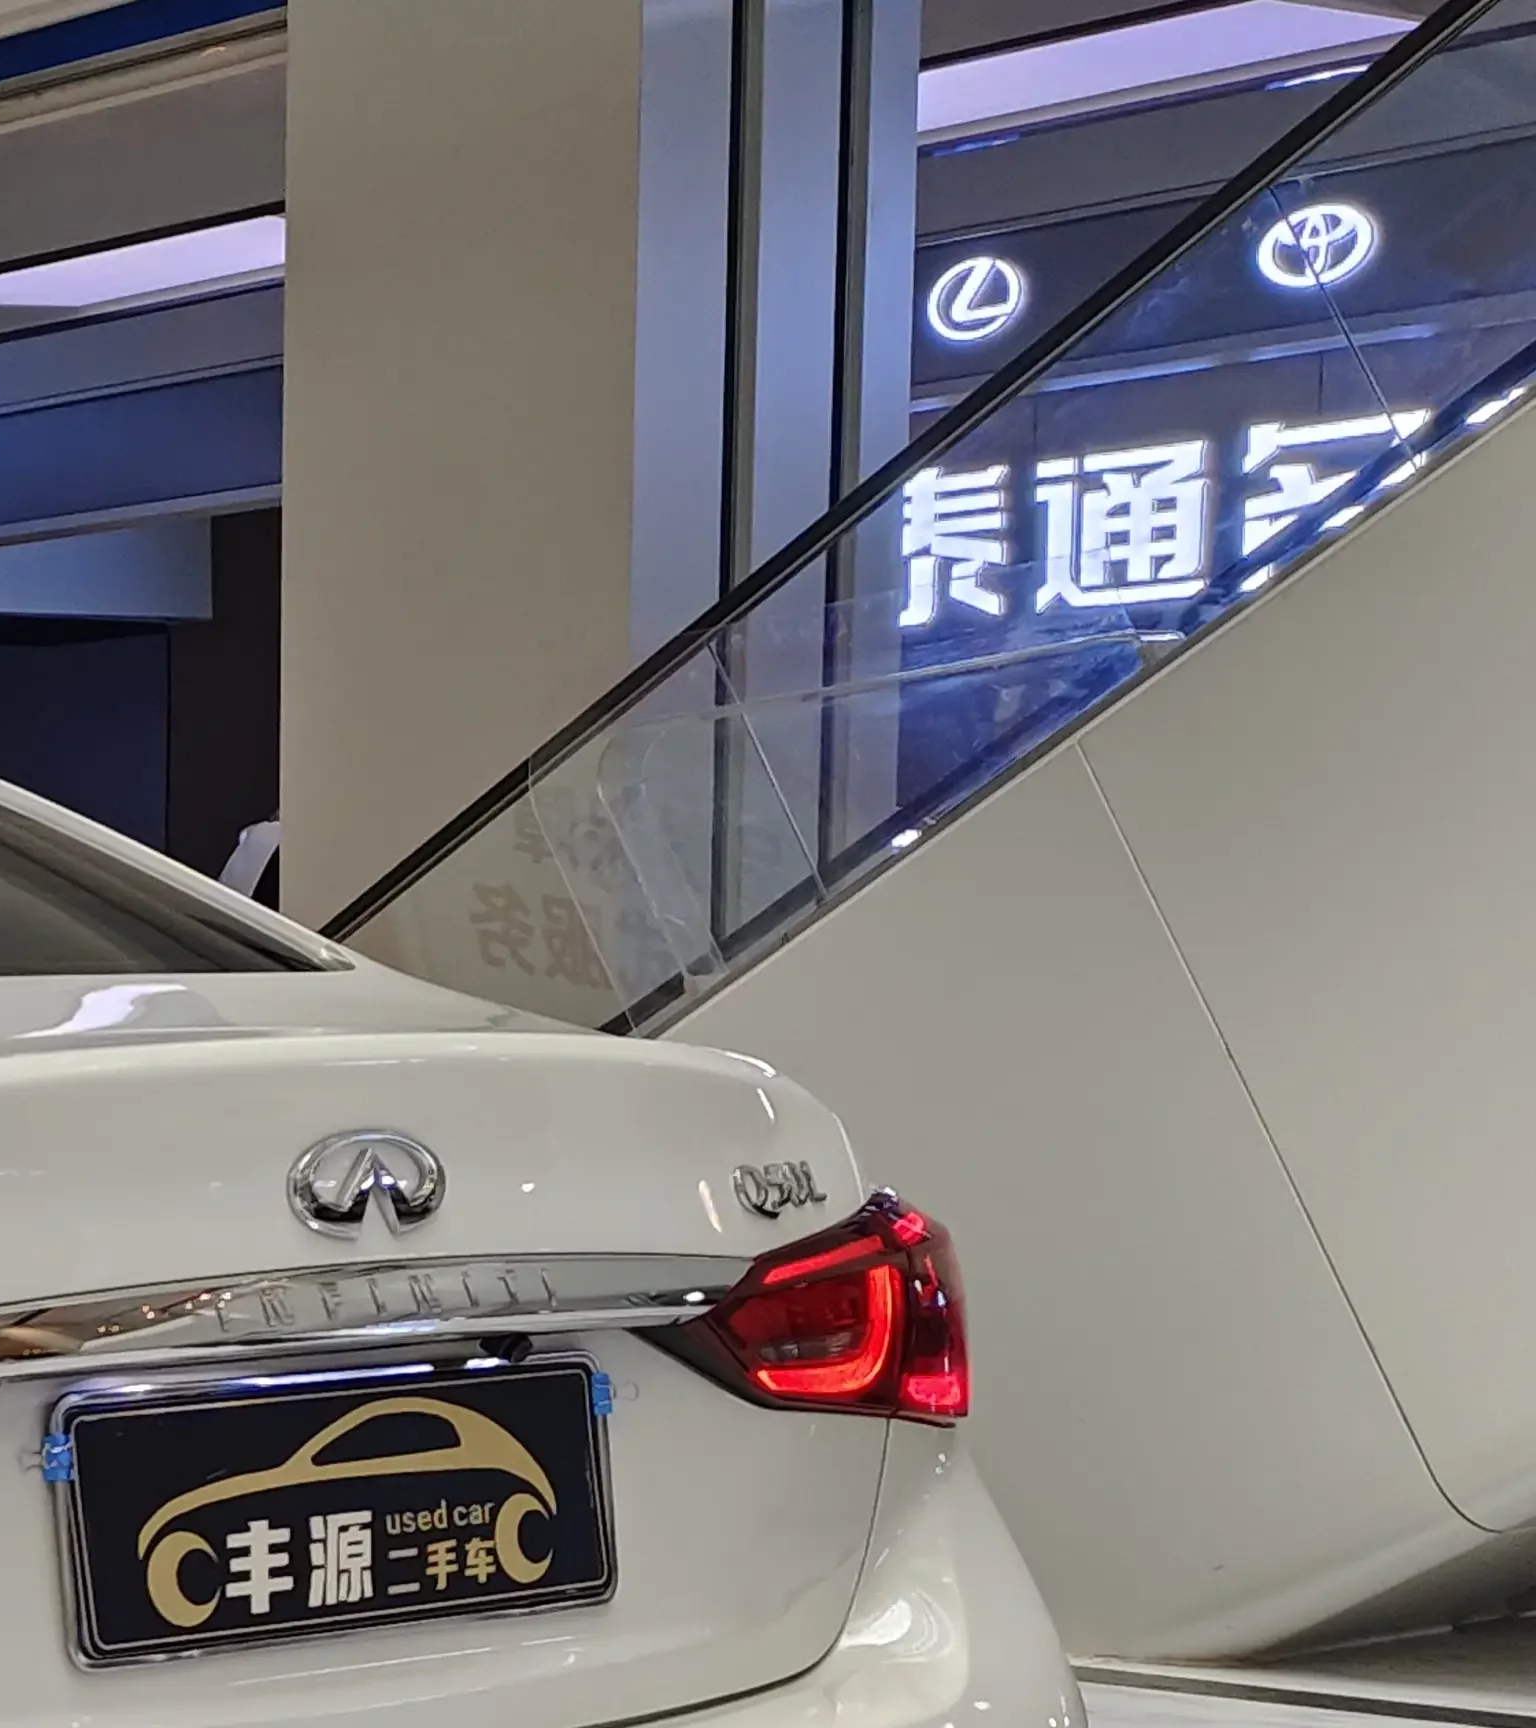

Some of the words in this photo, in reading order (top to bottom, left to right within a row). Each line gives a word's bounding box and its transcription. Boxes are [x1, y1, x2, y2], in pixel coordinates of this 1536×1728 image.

[385, 1499, 449, 1535] used
[453, 1500, 495, 1526] car
[225, 1510, 375, 1615] 丰源
[386, 1536, 496, 1595] 二手车
